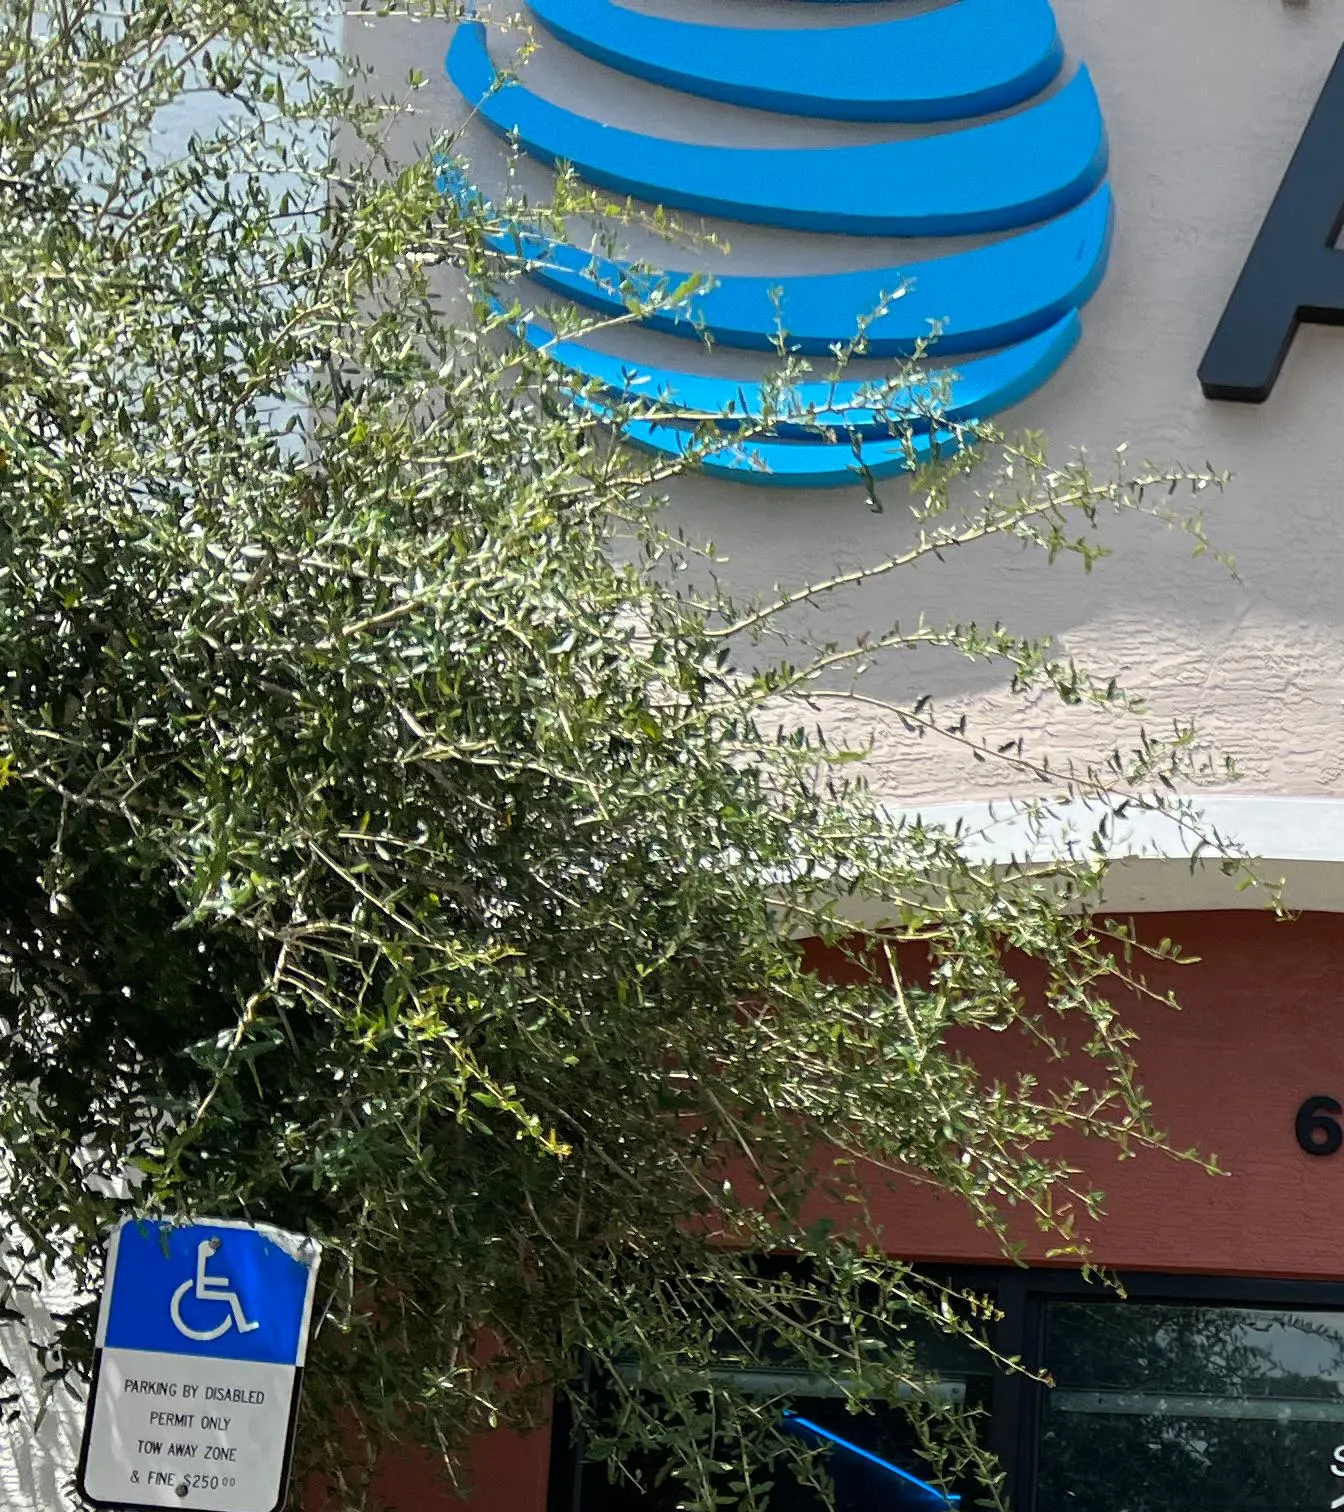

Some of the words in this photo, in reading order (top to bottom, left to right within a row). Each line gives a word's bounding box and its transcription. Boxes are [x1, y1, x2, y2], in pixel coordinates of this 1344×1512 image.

[124, 1379, 177, 1398] PARKING
[182, 1384, 199, 1399] BY
[204, 1386, 265, 1405] DISABLED
[149, 1411, 194, 1429] PERMIT
[200, 1415, 232, 1432] ONLY
[137, 1439, 163, 1455] TOW
[167, 1442, 199, 1459] AWAY
[203, 1446, 237, 1462] ZONE
[129, 1469, 141, 1484] &
[147, 1471, 175, 1487] FINE
